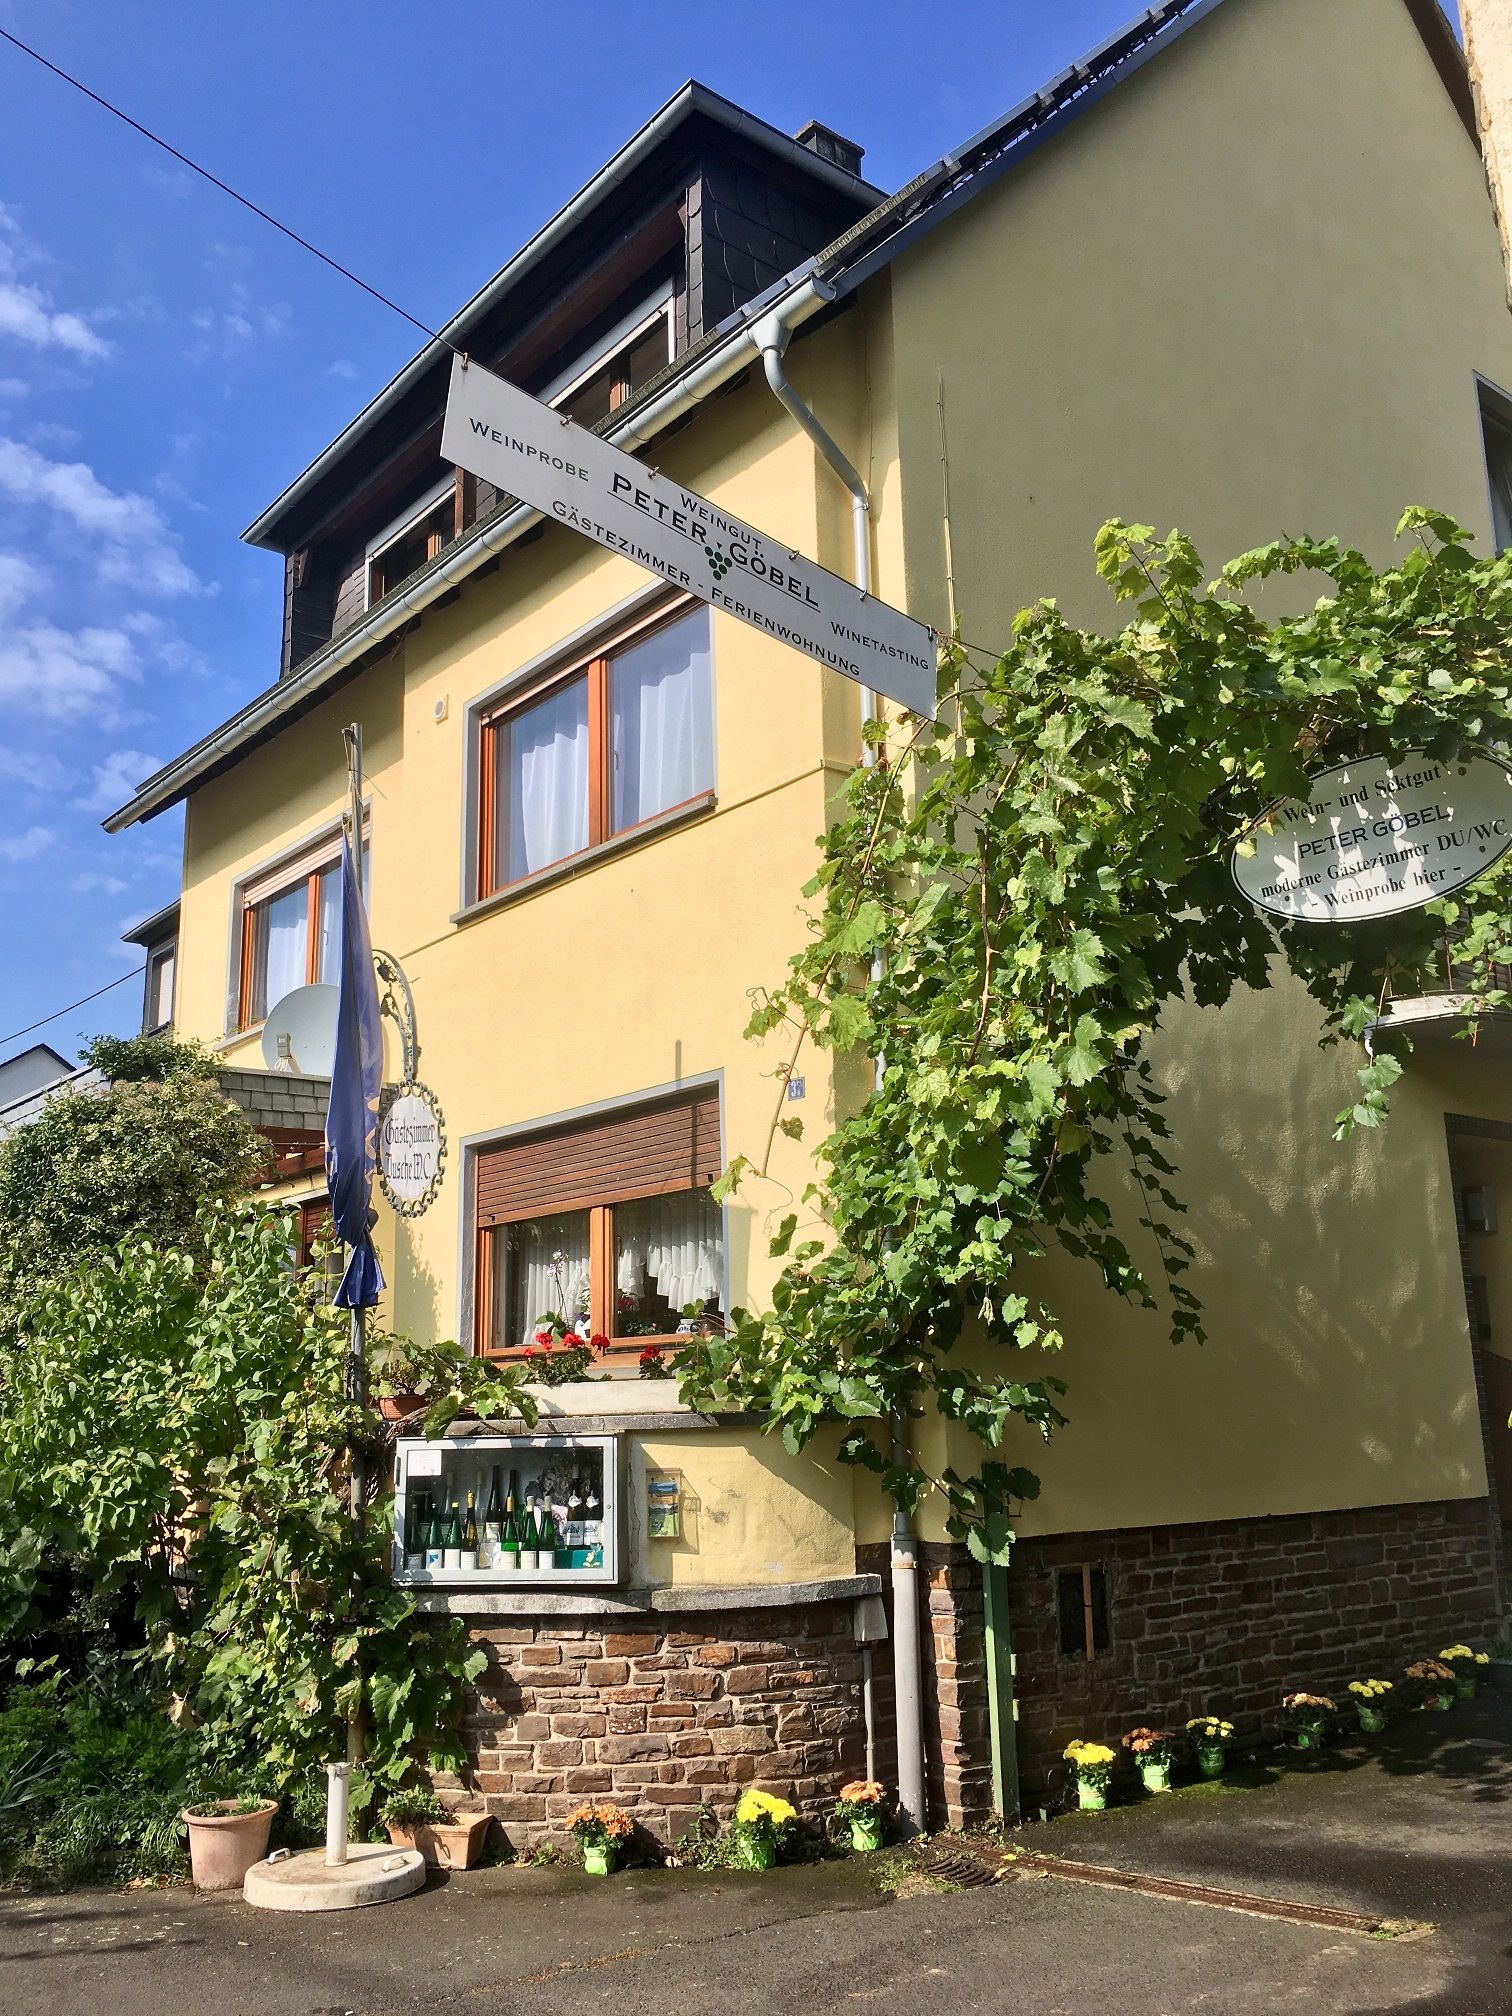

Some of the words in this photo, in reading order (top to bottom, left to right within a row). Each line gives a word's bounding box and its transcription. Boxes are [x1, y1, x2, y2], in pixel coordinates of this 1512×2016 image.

[469, 417, 590, 482] WEINPROBE
[611, 472, 708, 544] PETER
[729, 541, 819, 608] GÖBEL
[680, 493, 763, 549] WEINGUT
[552, 500, 691, 588] GÄSTEZIMMER
[710, 587, 860, 677] FERIENWOHNUNG
[830, 621, 929, 671] WINETASTING
[1283, 801, 1332, 823] Wein-
[1339, 786, 1369, 807] und
[1375, 764, 1442, 797] Sektgut
[1261, 873, 1322, 898] moderne
[1327, 843, 1430, 880] Gästezimmer
[1437, 818, 1507, 851] DU/WC
[1298, 827, 1369, 859] PETER
[1373, 804, 1450, 837] GÖBEL
[1324, 877, 1406, 908] Weinprobe
[1413, 869, 1446, 887] hier
[384, 1116, 436, 1148] Gästezimmer
